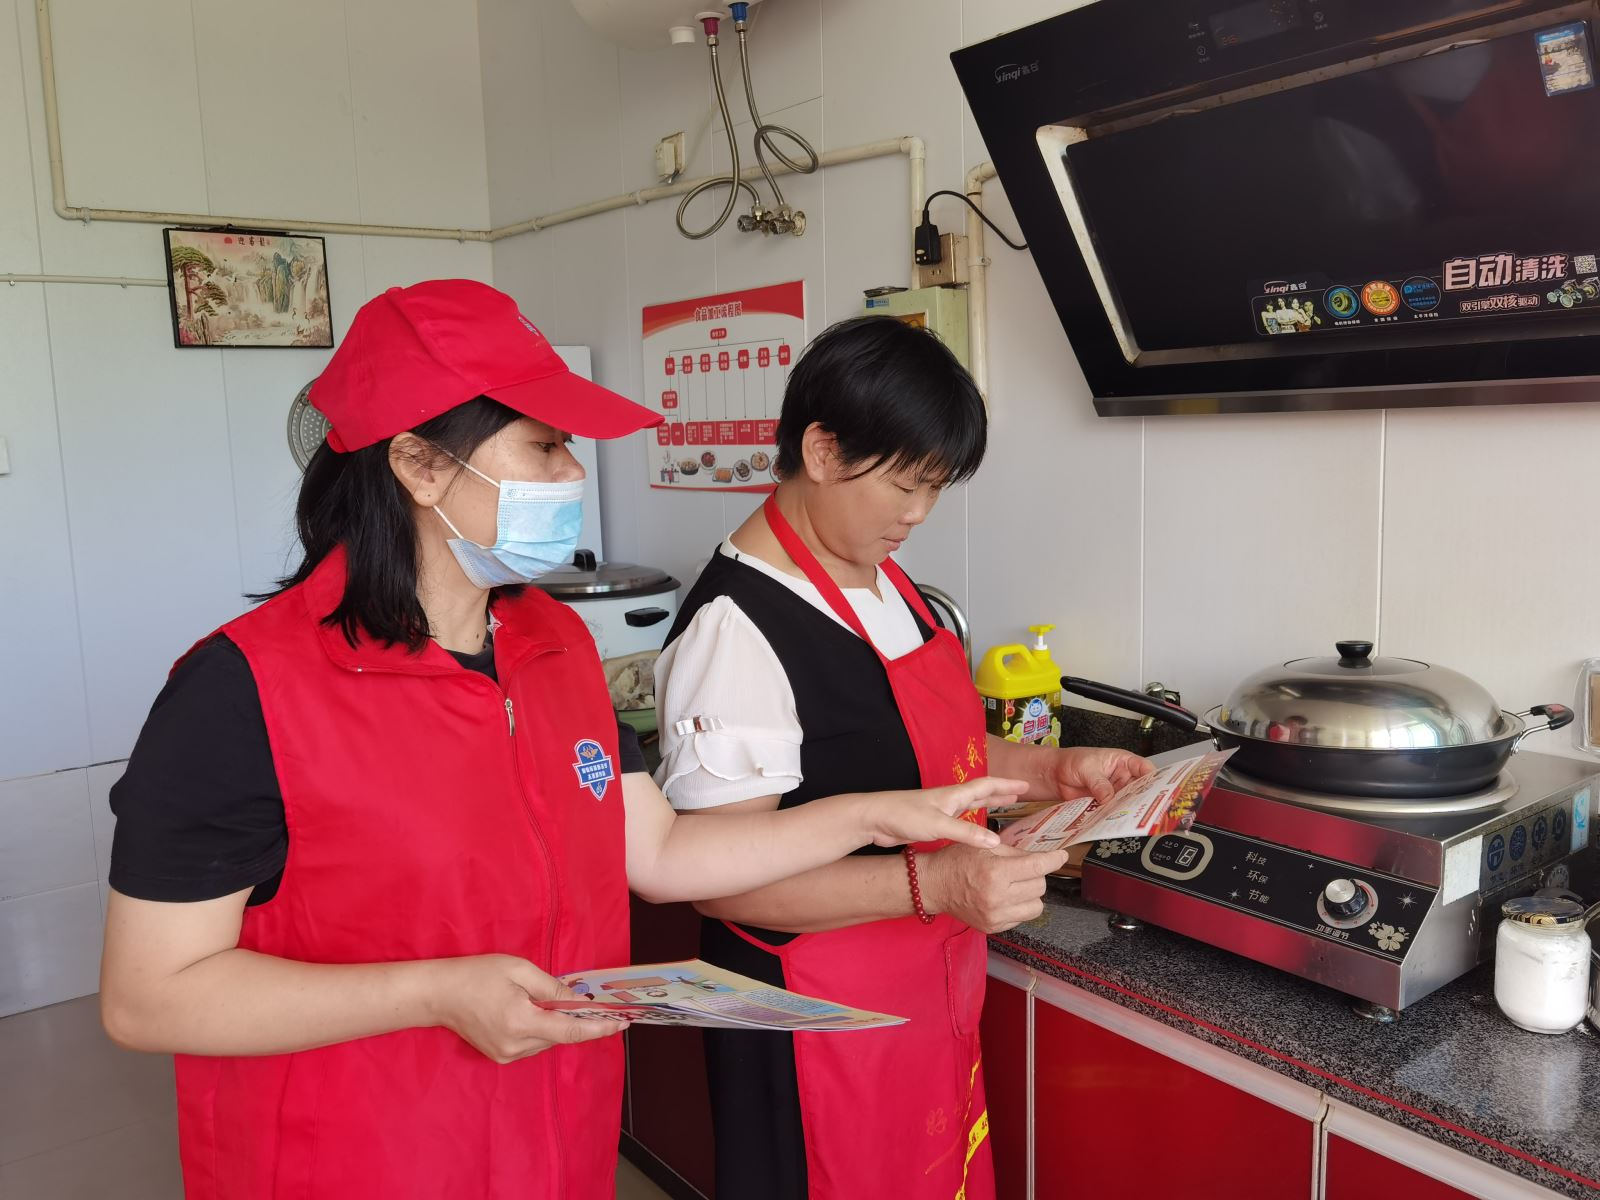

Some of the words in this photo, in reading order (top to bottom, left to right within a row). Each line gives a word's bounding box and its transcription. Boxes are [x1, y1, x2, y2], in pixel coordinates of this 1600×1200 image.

[1445, 254, 1567, 290] 自动清洗
[1461, 295, 1538, 312] 双引擎双核驱动
[1246, 851, 1267, 866] 科技
[1246, 870, 1268, 884] 环保
[1248, 889, 1269, 904] 节能
